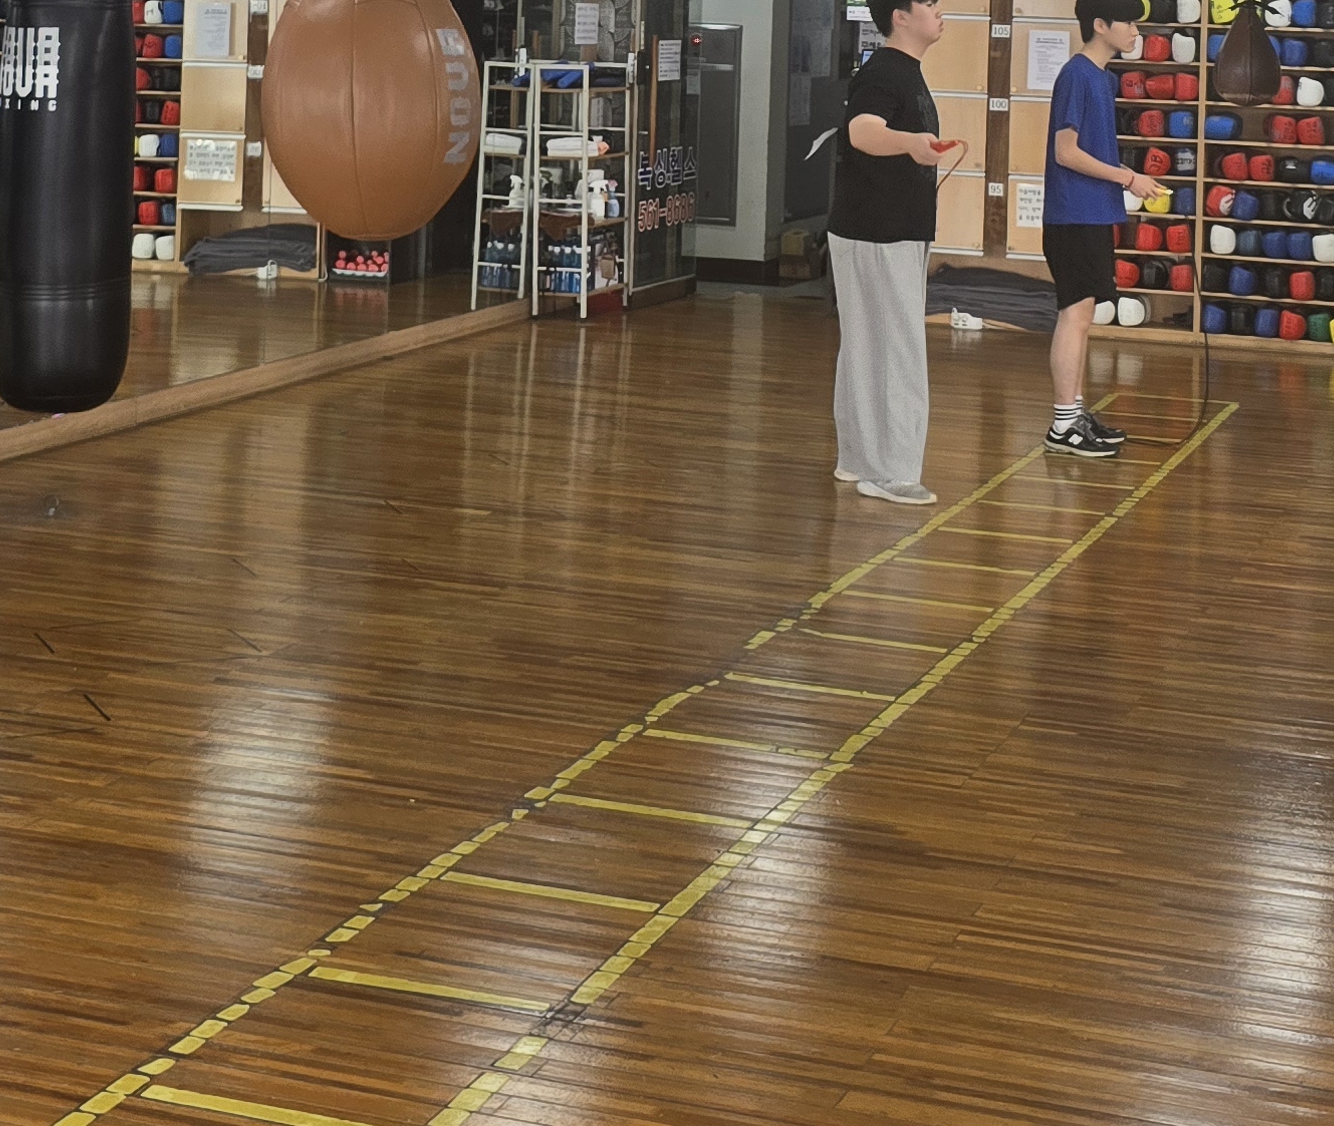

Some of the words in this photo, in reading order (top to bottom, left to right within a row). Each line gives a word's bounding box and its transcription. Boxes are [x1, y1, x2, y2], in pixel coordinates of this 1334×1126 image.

[992, 26, 1009, 36] 105
[0, 98, 58, 112] XING
[990, 99, 1008, 110] 100
[990, 184, 1002, 194] 95
[638, 191, 696, 233] 561-8686
